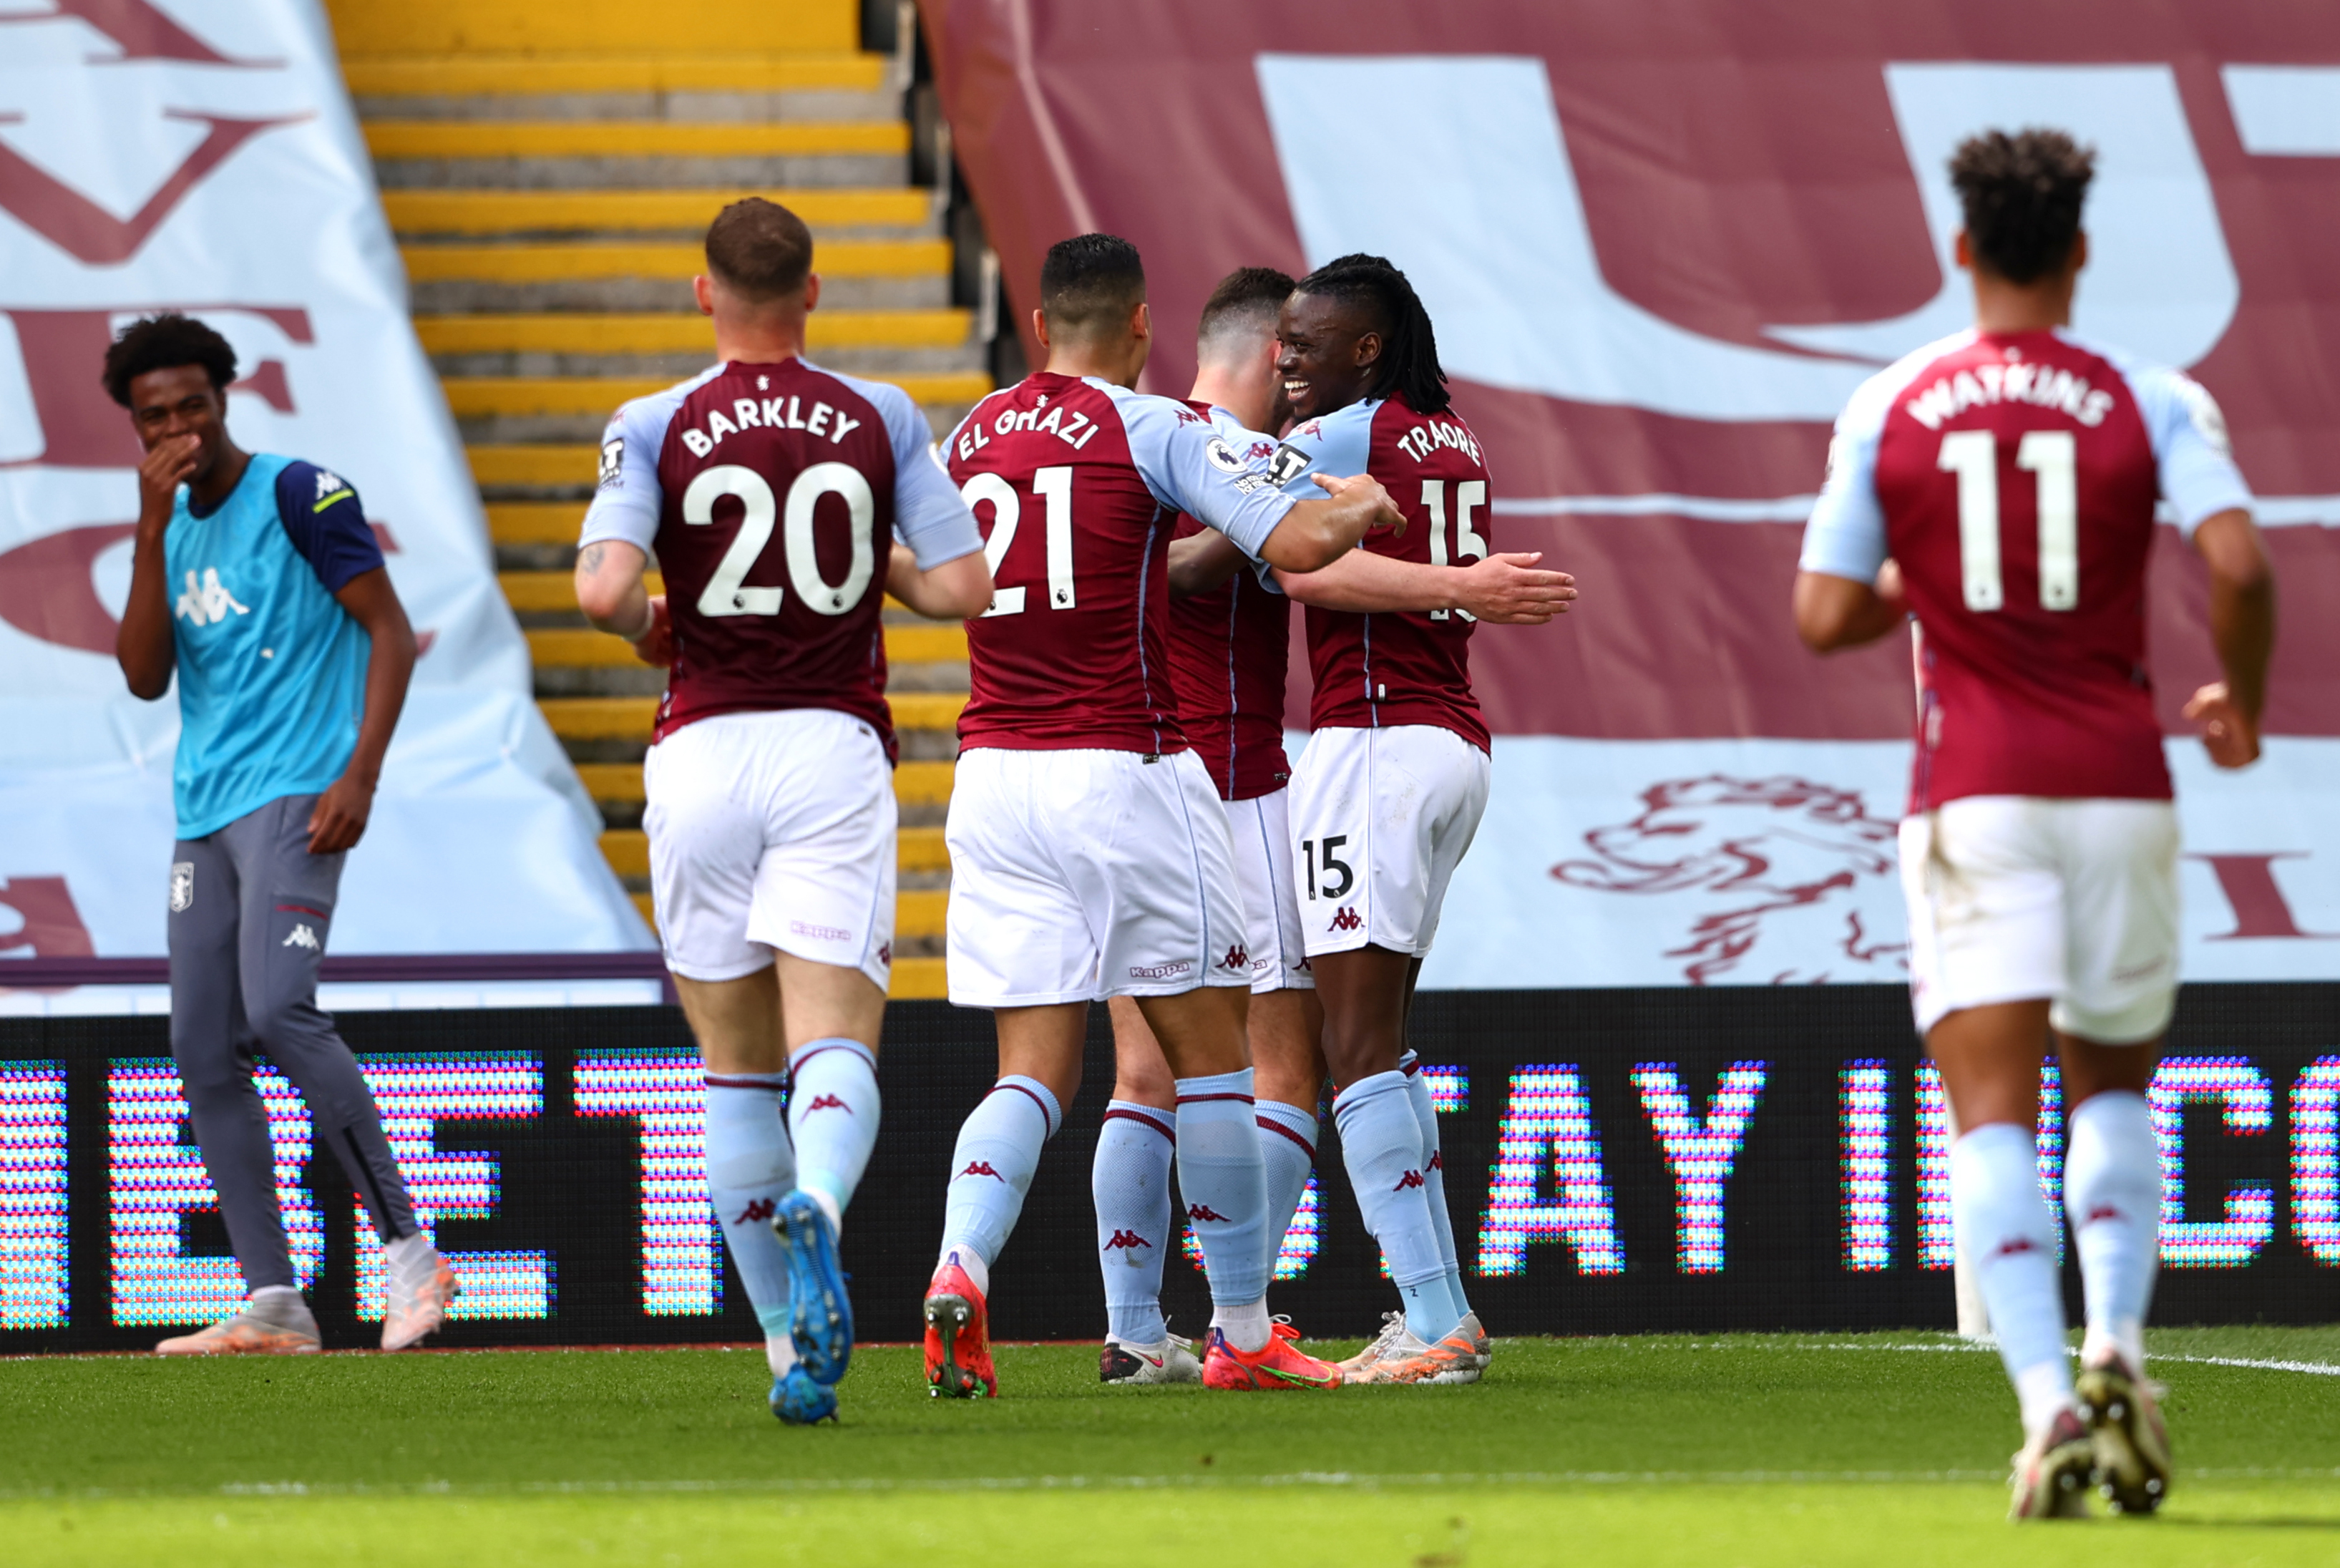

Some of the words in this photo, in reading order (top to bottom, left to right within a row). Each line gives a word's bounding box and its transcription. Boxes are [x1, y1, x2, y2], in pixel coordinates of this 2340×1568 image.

[681, 396, 861, 459] BARKLEY
[1906, 364, 2116, 429] WATKINS
[958, 423, 990, 462] EL
[995, 406, 1100, 450] GHAZI
[682, 462, 874, 617] 20
[960, 466, 1076, 618] 21
[1420, 479, 1488, 623] 15
[1936, 430, 2080, 612] 11
[1302, 834, 1353, 901] 15
[1130, 961, 1190, 979] Kappa
